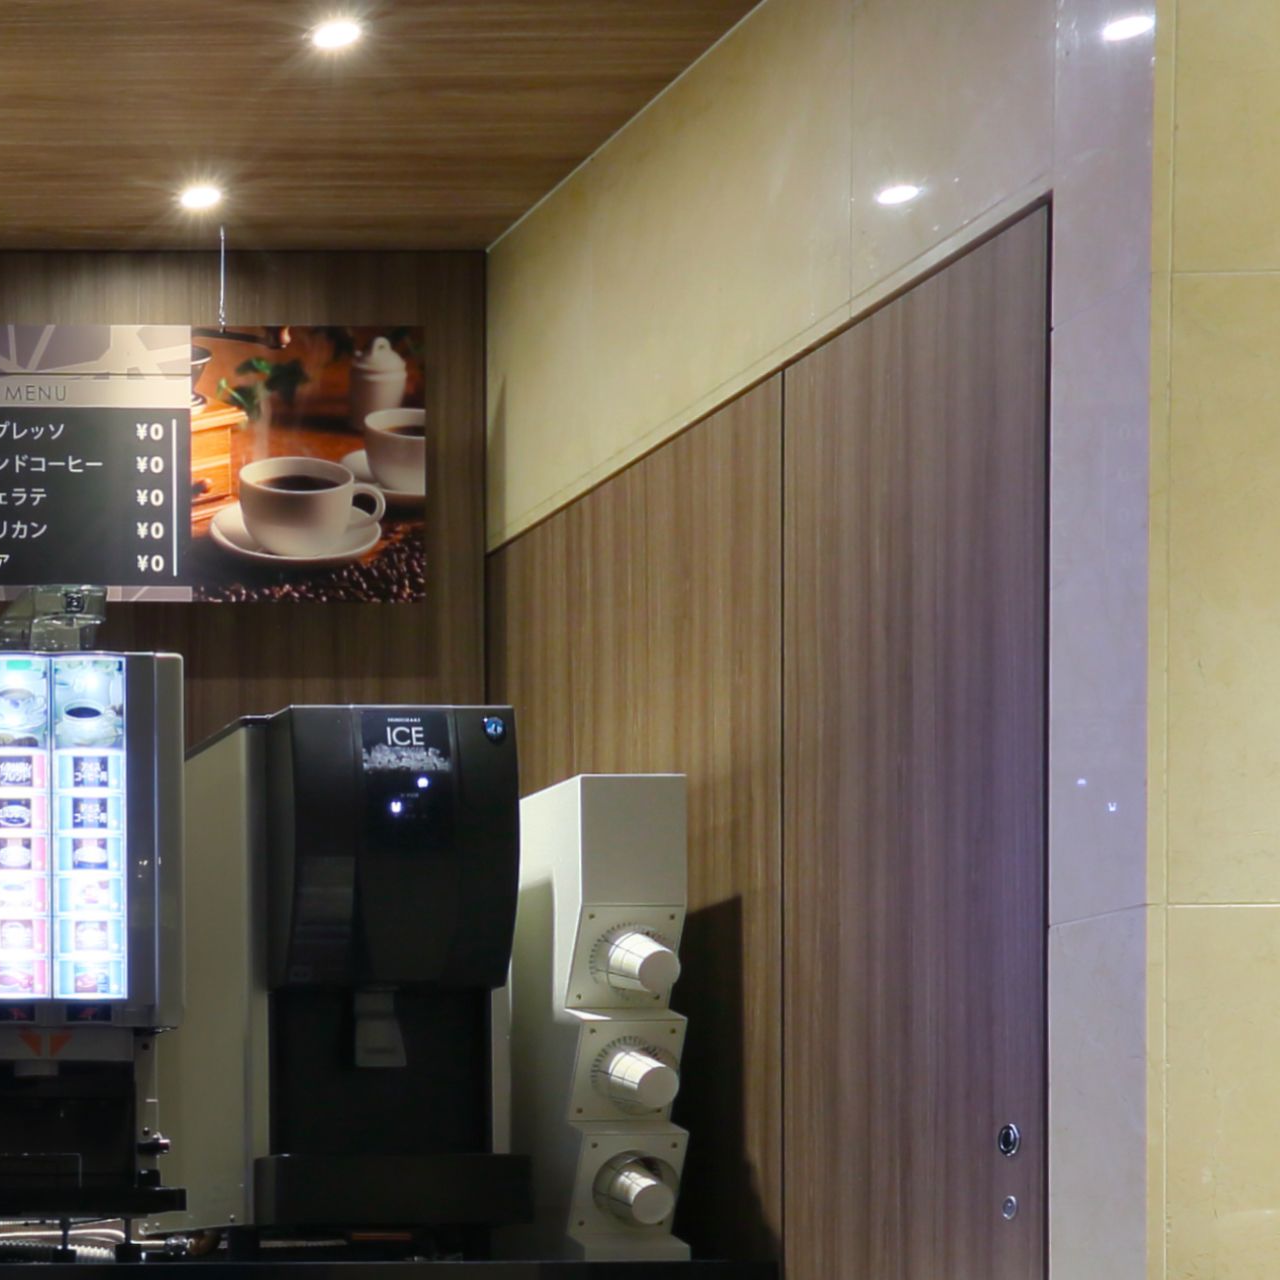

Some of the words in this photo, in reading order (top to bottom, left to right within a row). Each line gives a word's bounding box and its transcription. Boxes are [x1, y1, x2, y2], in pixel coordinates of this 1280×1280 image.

[6, 384, 67, 401] MENU
[136, 423, 164, 441] ¥0
[136, 456, 164, 473] ¥0
[136, 490, 164, 506] ¥0
[137, 523, 164, 540] ¥0
[137, 555, 164, 572] ¥0
[386, 726, 425, 746] ICE
